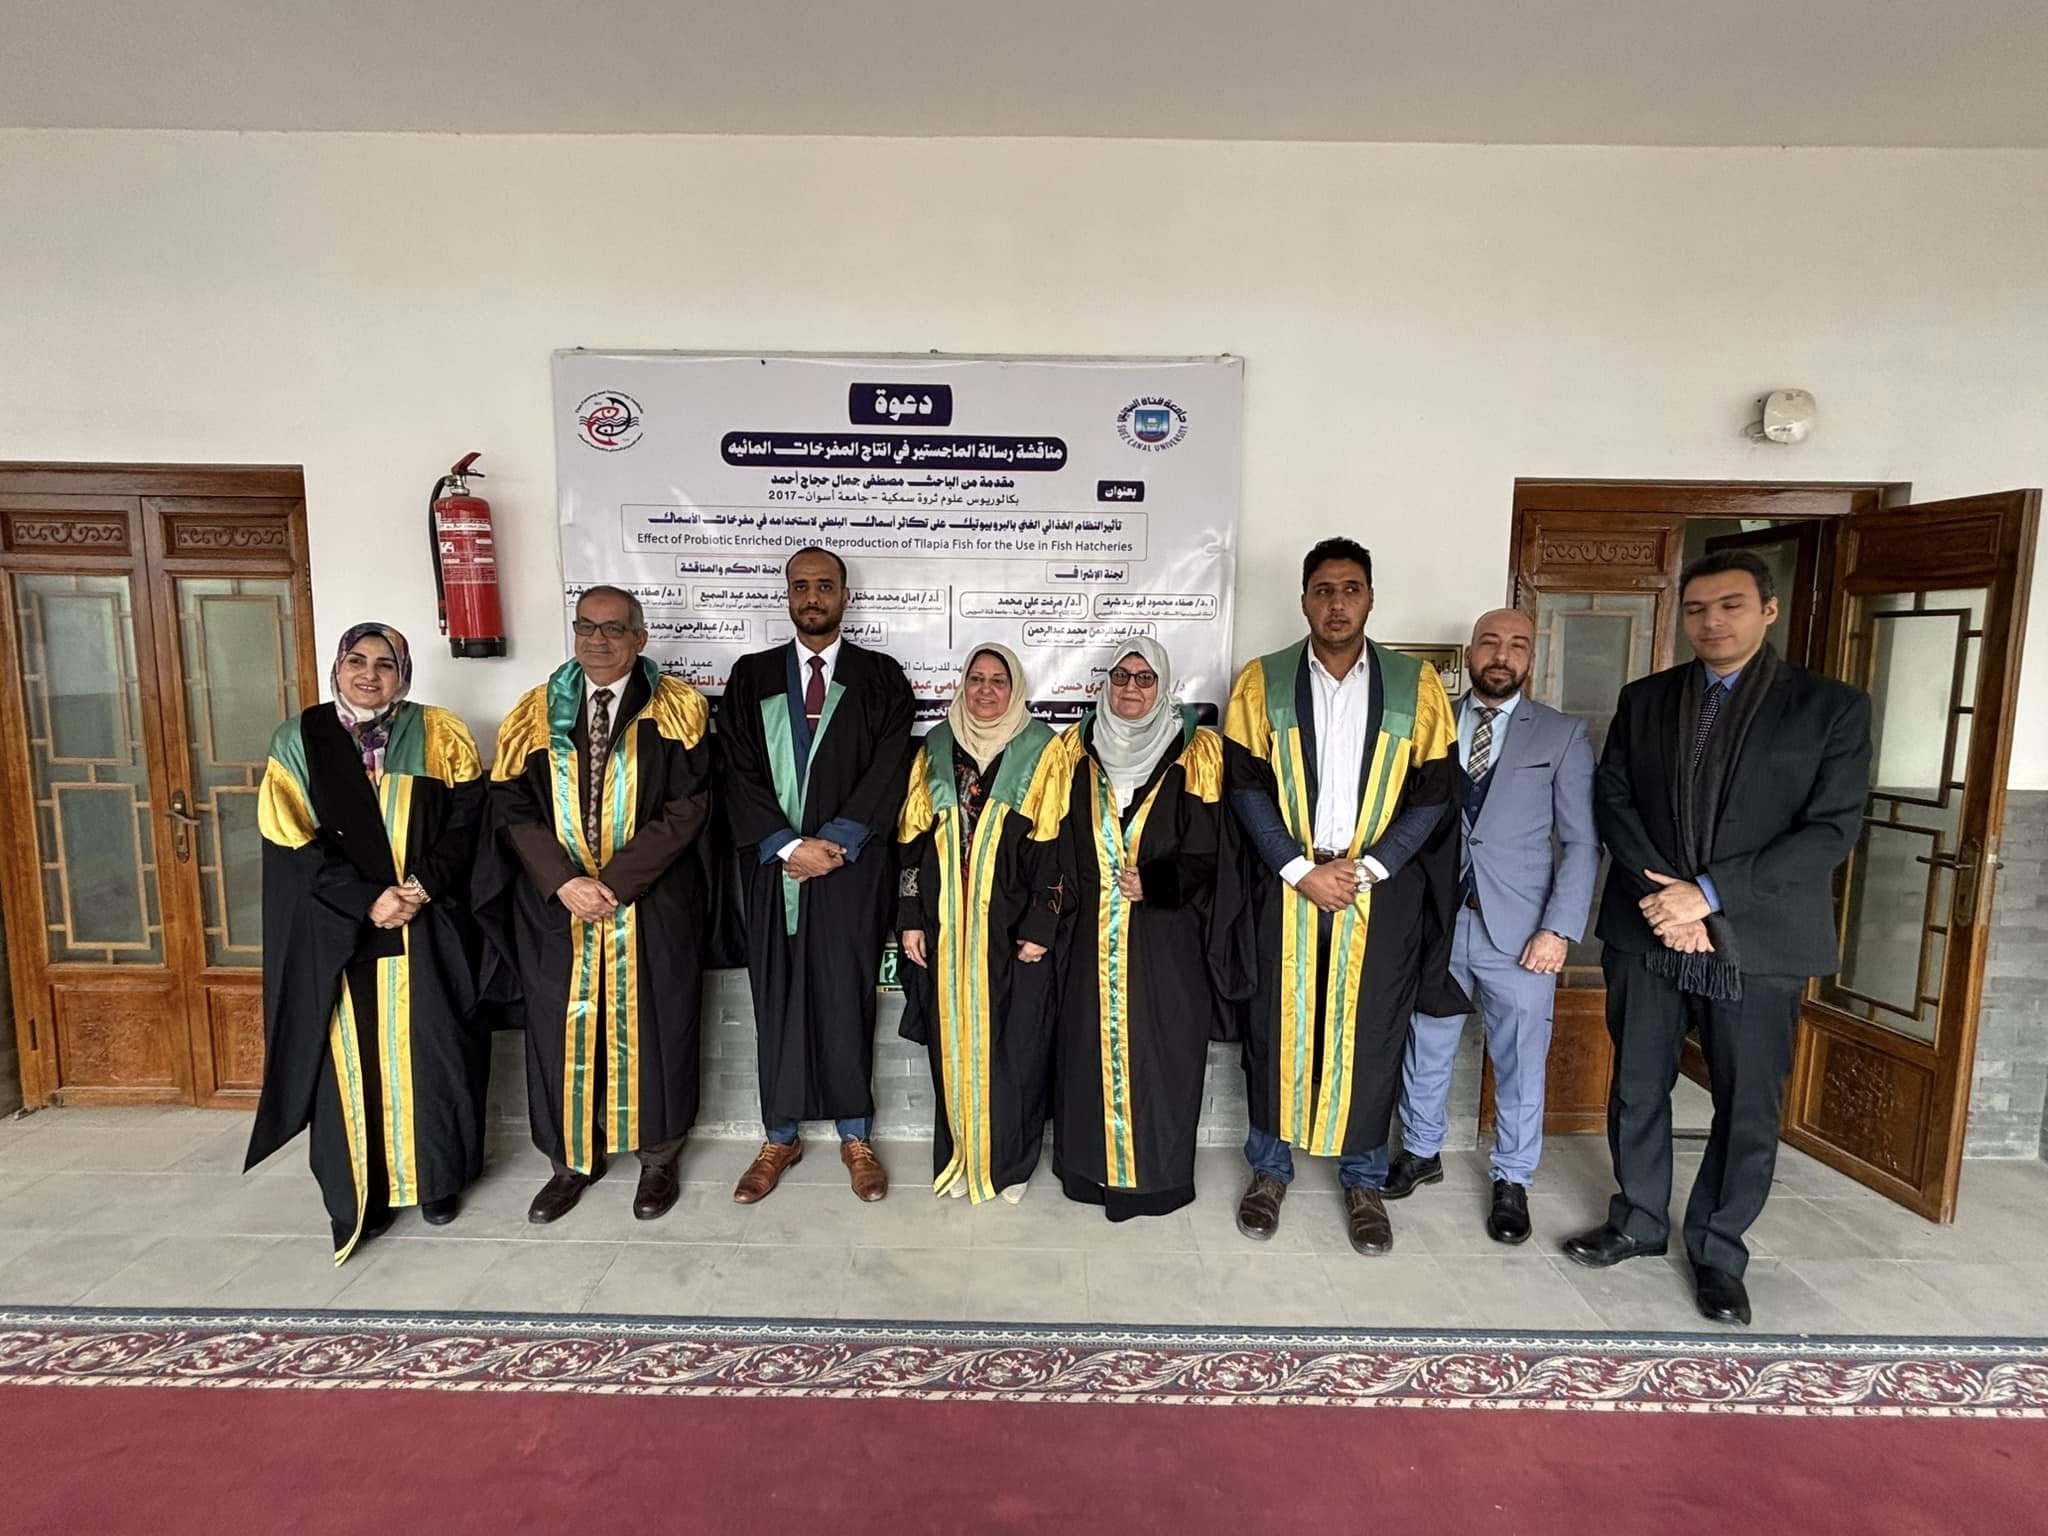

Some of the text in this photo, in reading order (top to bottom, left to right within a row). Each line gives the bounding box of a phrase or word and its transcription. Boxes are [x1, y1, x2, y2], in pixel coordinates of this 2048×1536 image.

[875, 389, 932, 421] دعوة
[773, 441, 859, 460] المفرخات
[1016, 442, 1063, 460] مناقشة
[1127, 438, 1152, 452] CANAL
[861, 442, 891, 462] انتاج
[893, 440, 910, 464] في
[911, 443, 976, 461] الماجستير
[978, 443, 1014, 462] رسالة
[771, 471, 1015, 490] مقدمة من الباحث مصطفى جمال حجاج أحمد
[838, 492, 868, 504] جامعة
[882, 492, 915, 505] سمكية
[1104, 485, 1137, 499] بعنوان
[918, 493, 938, 505] ثروة
[941, 493, 963, 506] علوم
[966, 493, 1019, 506] بكالوريوس
[648, 511, 701, 524] الأسماك
[702, 514, 754, 527] مفرخات
[756, 512, 767, 530] في
[769, 514, 818, 527] لاستخدامه
[818, 516, 848, 531] البلطي
[850, 514, 896, 528] أسماك
[897, 516, 929, 530] تكاثر
[930, 517, 946, 531] على
[637, 533, 1133, 551] Effect of Probiotic Enriched Diet on Reproduction of Tilapia Fish for the Use in Fish Hatcheries
[680, 561, 782, 577] لجنة الحكم والمناقشة
[1104, 569, 1123, 581] لجنة
[641, 587, 660, 596] صفاء
[700, 590, 789, 603] شرف محمد عبد السميع
[851, 592, 875, 603] مختار
[876, 594, 900, 602] محمد
[998, 597, 1022, 606] محمد
[1041, 597, 1063, 609] مرفت
[1102, 597, 1120, 608] شرف
[1136, 596, 1146, 608] أبو
[1148, 599, 1173, 608] محمود
[1174, 598, 1193, 606] صفاء
[650, 621, 673, 630] محمد
[843, 624, 864, 636] مرفت
[1066, 627, 1087, 635] محمد
[661, 656, 713, 670] عميد المعهد
[1051, 681, 1083, 695] حسين
